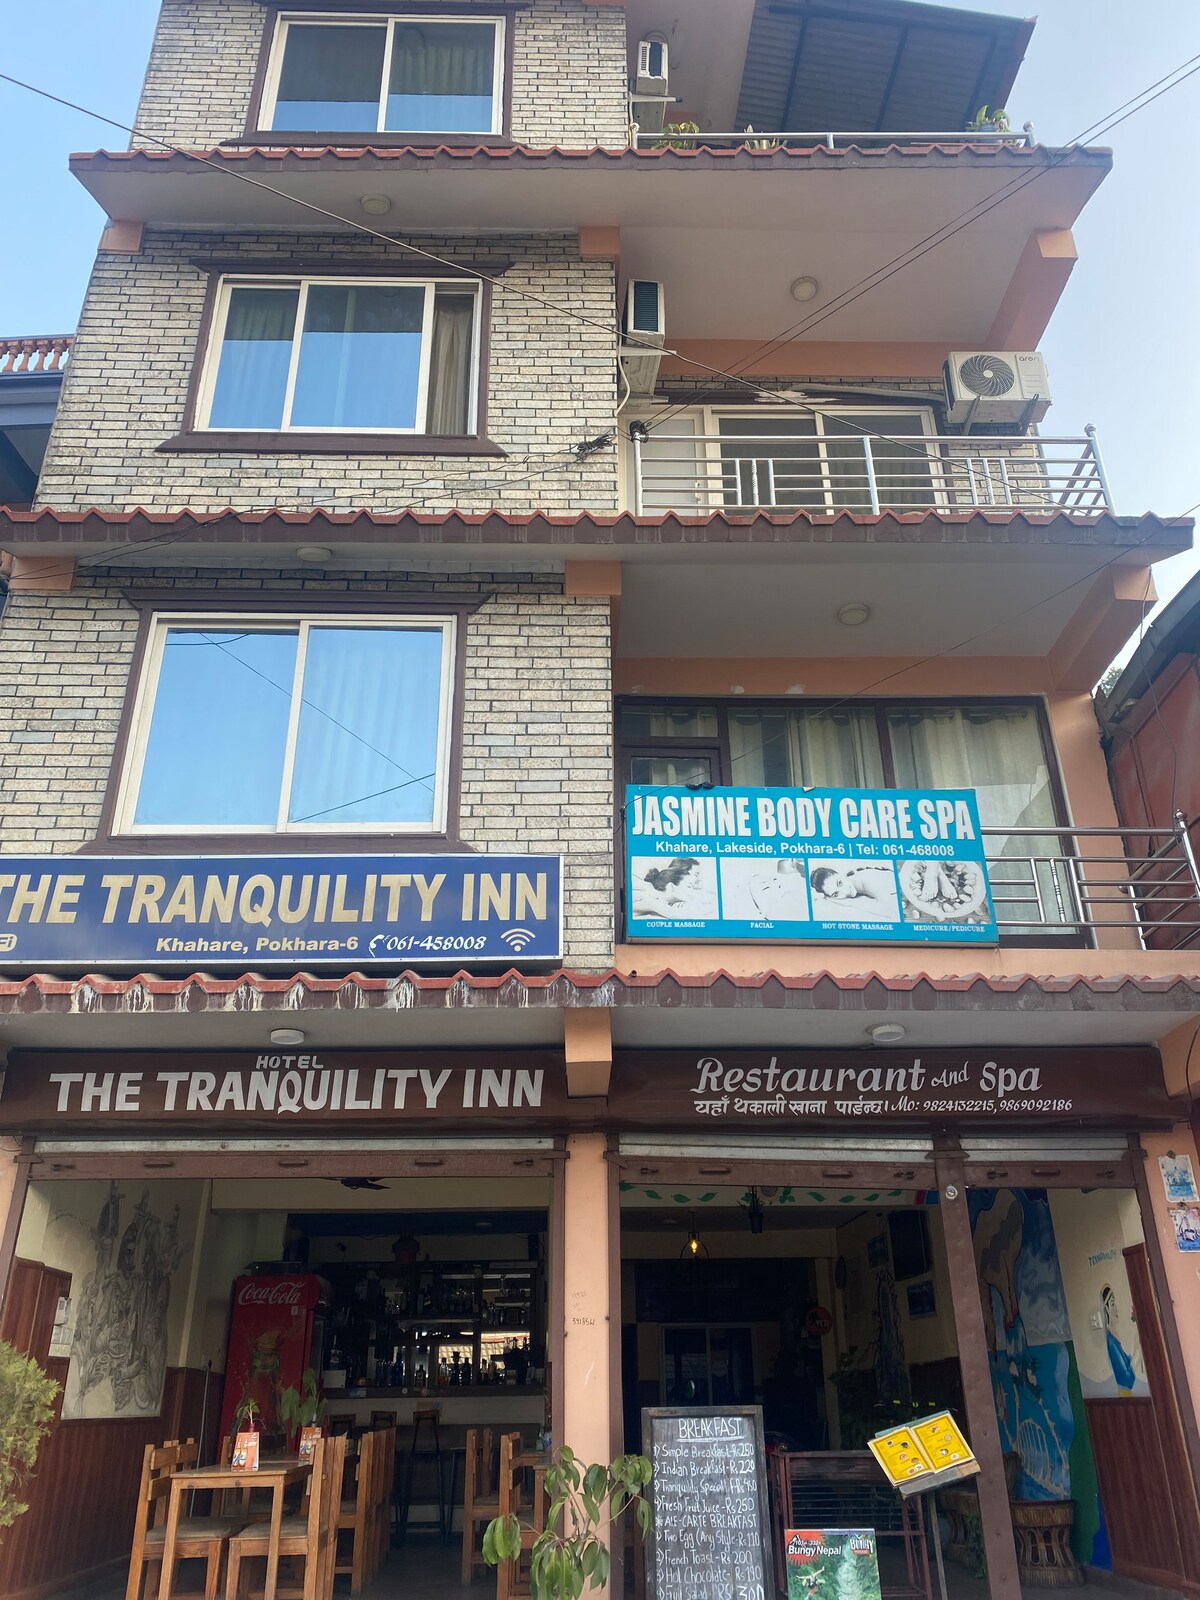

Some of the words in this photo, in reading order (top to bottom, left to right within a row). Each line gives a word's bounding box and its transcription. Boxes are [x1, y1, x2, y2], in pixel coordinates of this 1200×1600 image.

[632, 795, 750, 837] JASMINE
[756, 796, 834, 838] BODY
[840, 797, 912, 839] CARE
[917, 799, 976, 840] SPA
[656, 841, 713, 855] Khahare,
[716, 842, 777, 855] Lakeside,
[780, 842, 846, 855] Pokhara-6
[856, 843, 879, 856] Tel:
[882, 844, 955, 857] 061-468008
[101, 873, 446, 928] TRANQUILITY
[461, 872, 548, 922] INN
[156, 937, 249, 955] Khahare,
[255, 936, 359, 952] Pokhara-6
[386, 935, 487, 951] 061-458008
[256, 1054, 325, 1069] HOTEL
[690, 1056, 926, 1093] Restaurant
[931, 1061, 970, 1088] And
[979, 1061, 1043, 1098] Spa
[49, 1072, 143, 1112] THE
[156, 1068, 453, 1116] TRANQUILITY
[461, 1068, 545, 1108] INN
[733, 1093, 787, 1117] थकाली
[788, 1099, 828, 1116] खाना
[238, 1281, 306, 1306] Coca-Cola
[678, 1417, 742, 1438] BREAKFAST
[662, 1444, 689, 1463] Simple
[661, 1460, 689, 1477] Indian
[661, 1495, 683, 1512] Fresh
[701, 1499, 720, 1513] Juice
[735, 1497, 755, 1514] 250
[709, 1514, 757, 1529] BREAKFAST
[663, 1529, 678, 1542] Two
[679, 1529, 695, 1549] Egg
[665, 1549, 689, 1565] French
[690, 1549, 715, 1565] Toast
[731, 1550, 753, 1565] 200
[788, 1545, 816, 1557] Bungy
[817, 1545, 842, 1557] Nepal
[665, 1566, 682, 1584] Hot
